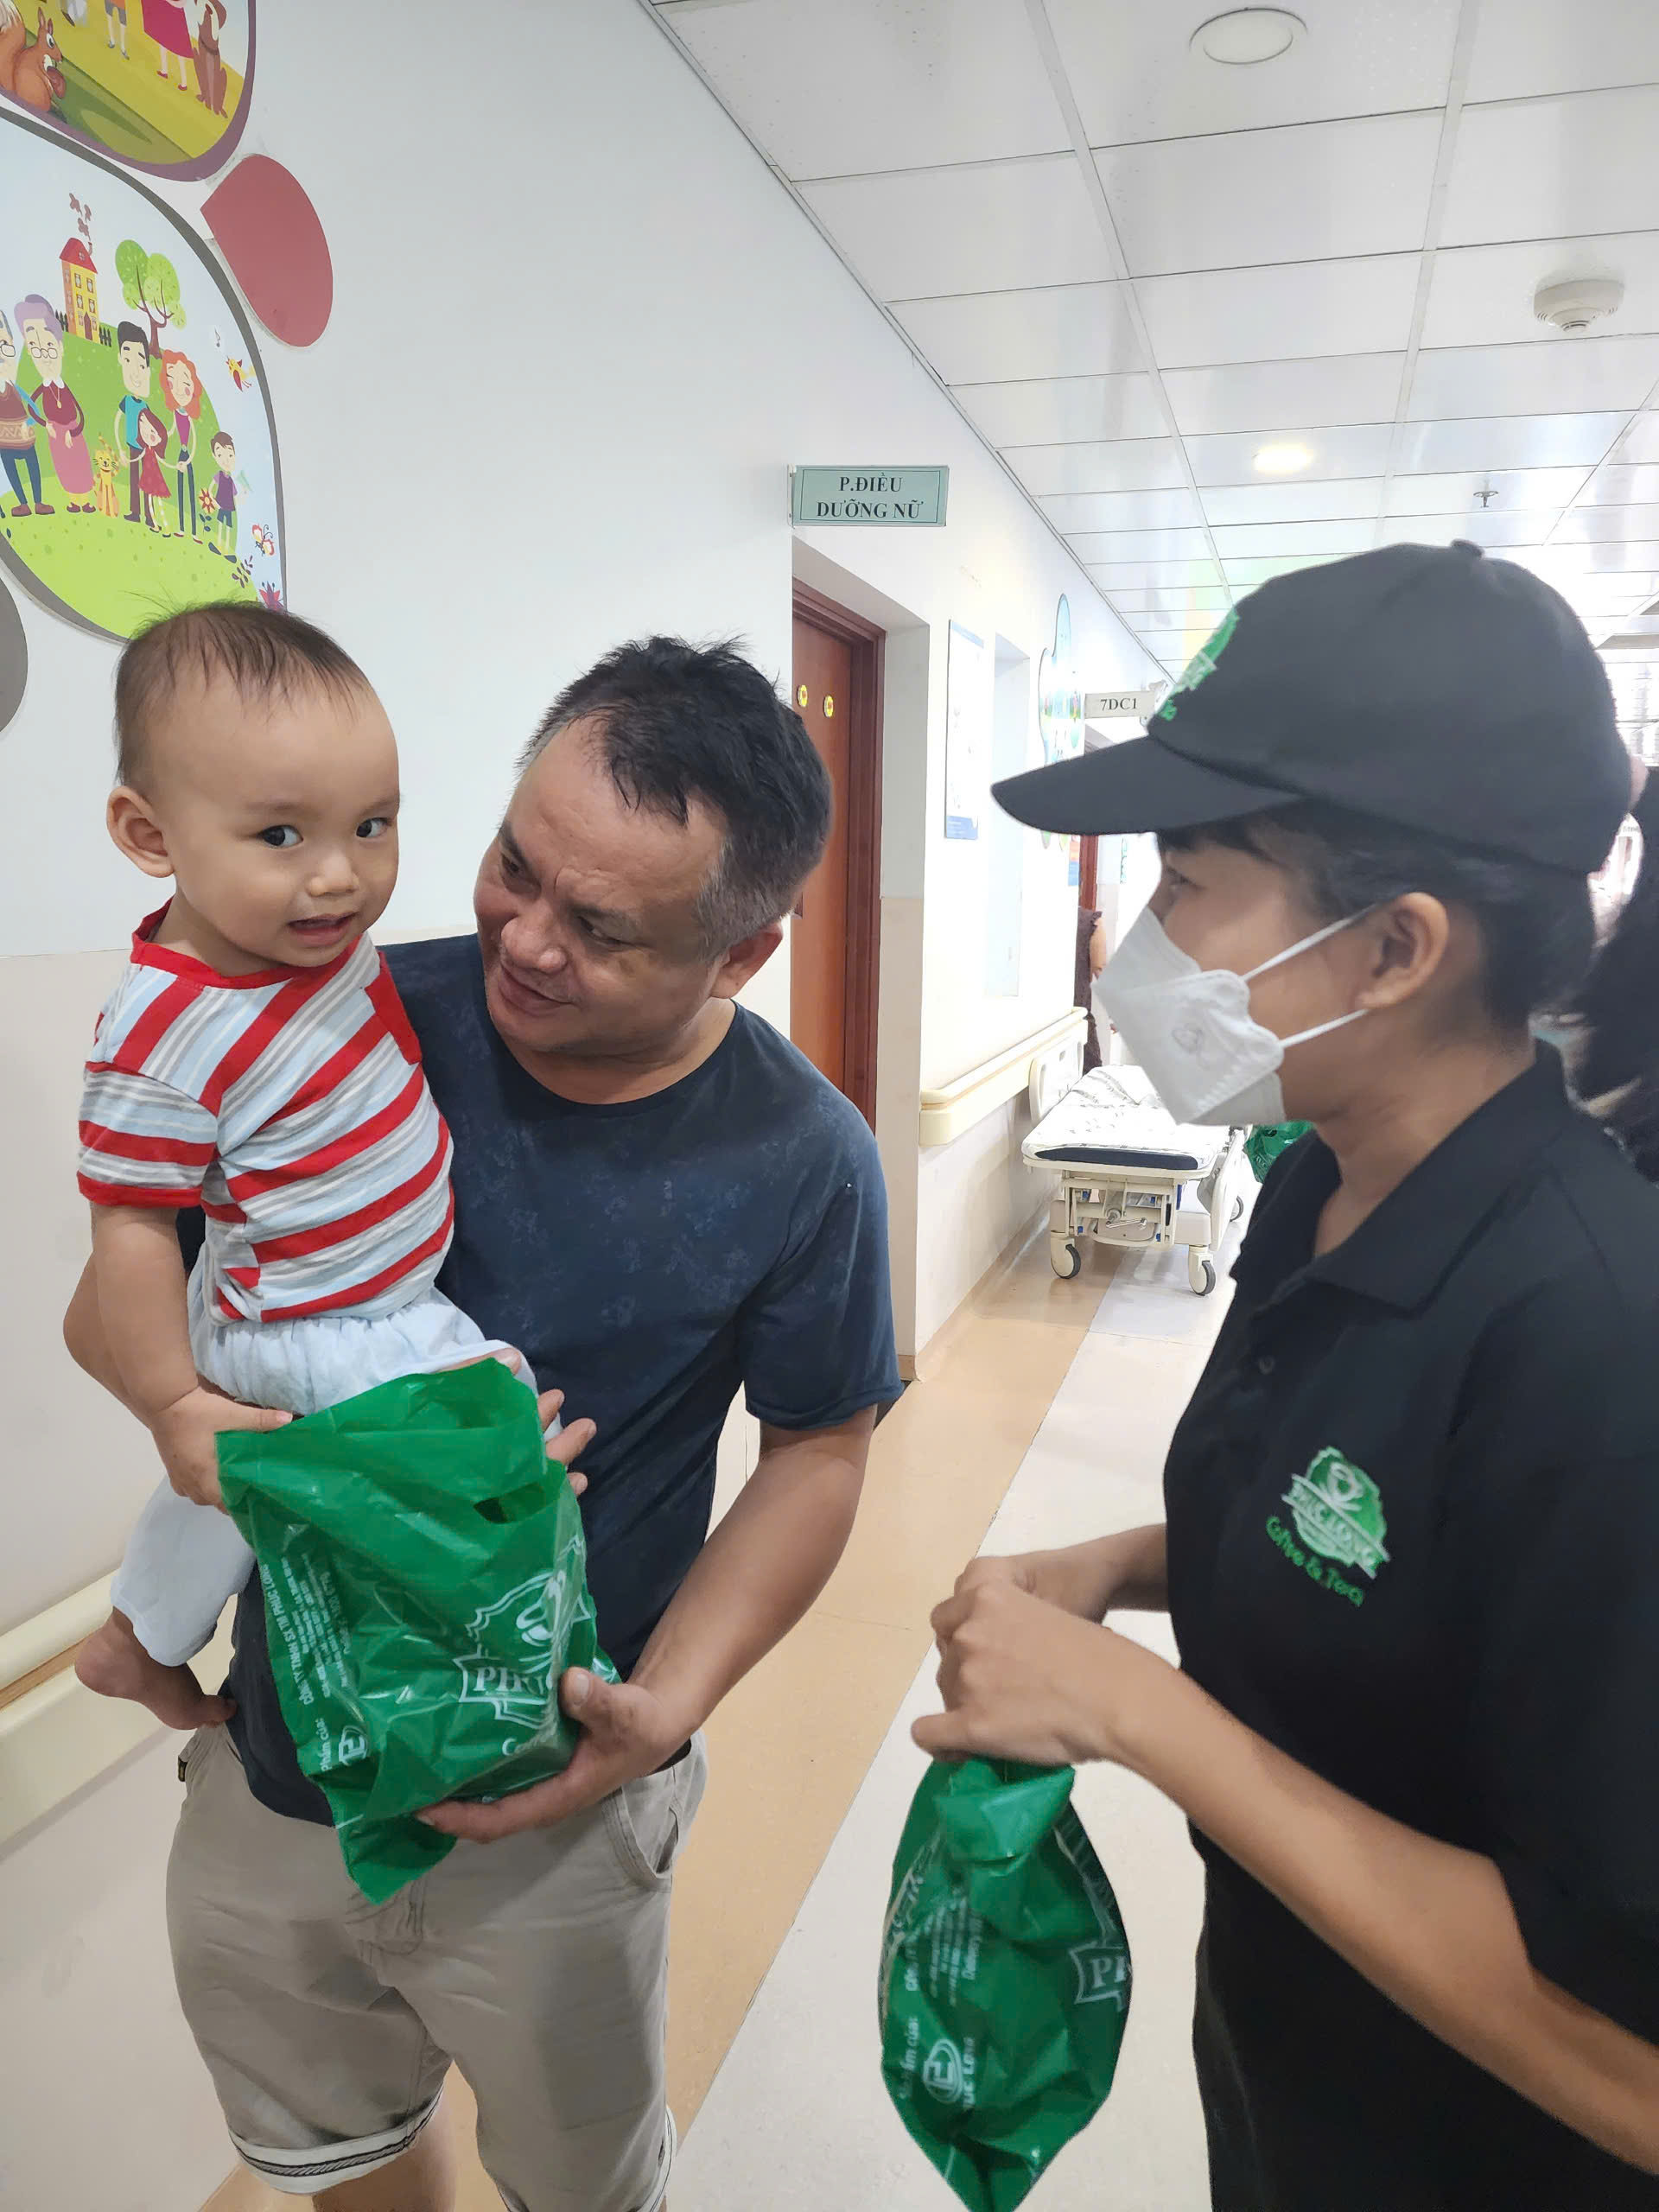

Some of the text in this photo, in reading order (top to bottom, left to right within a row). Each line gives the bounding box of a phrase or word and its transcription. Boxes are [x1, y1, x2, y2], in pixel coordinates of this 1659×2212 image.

[817, 499, 924, 518] DƯỠNG NỮ
[1100, 697, 1137, 711] 7DC1
